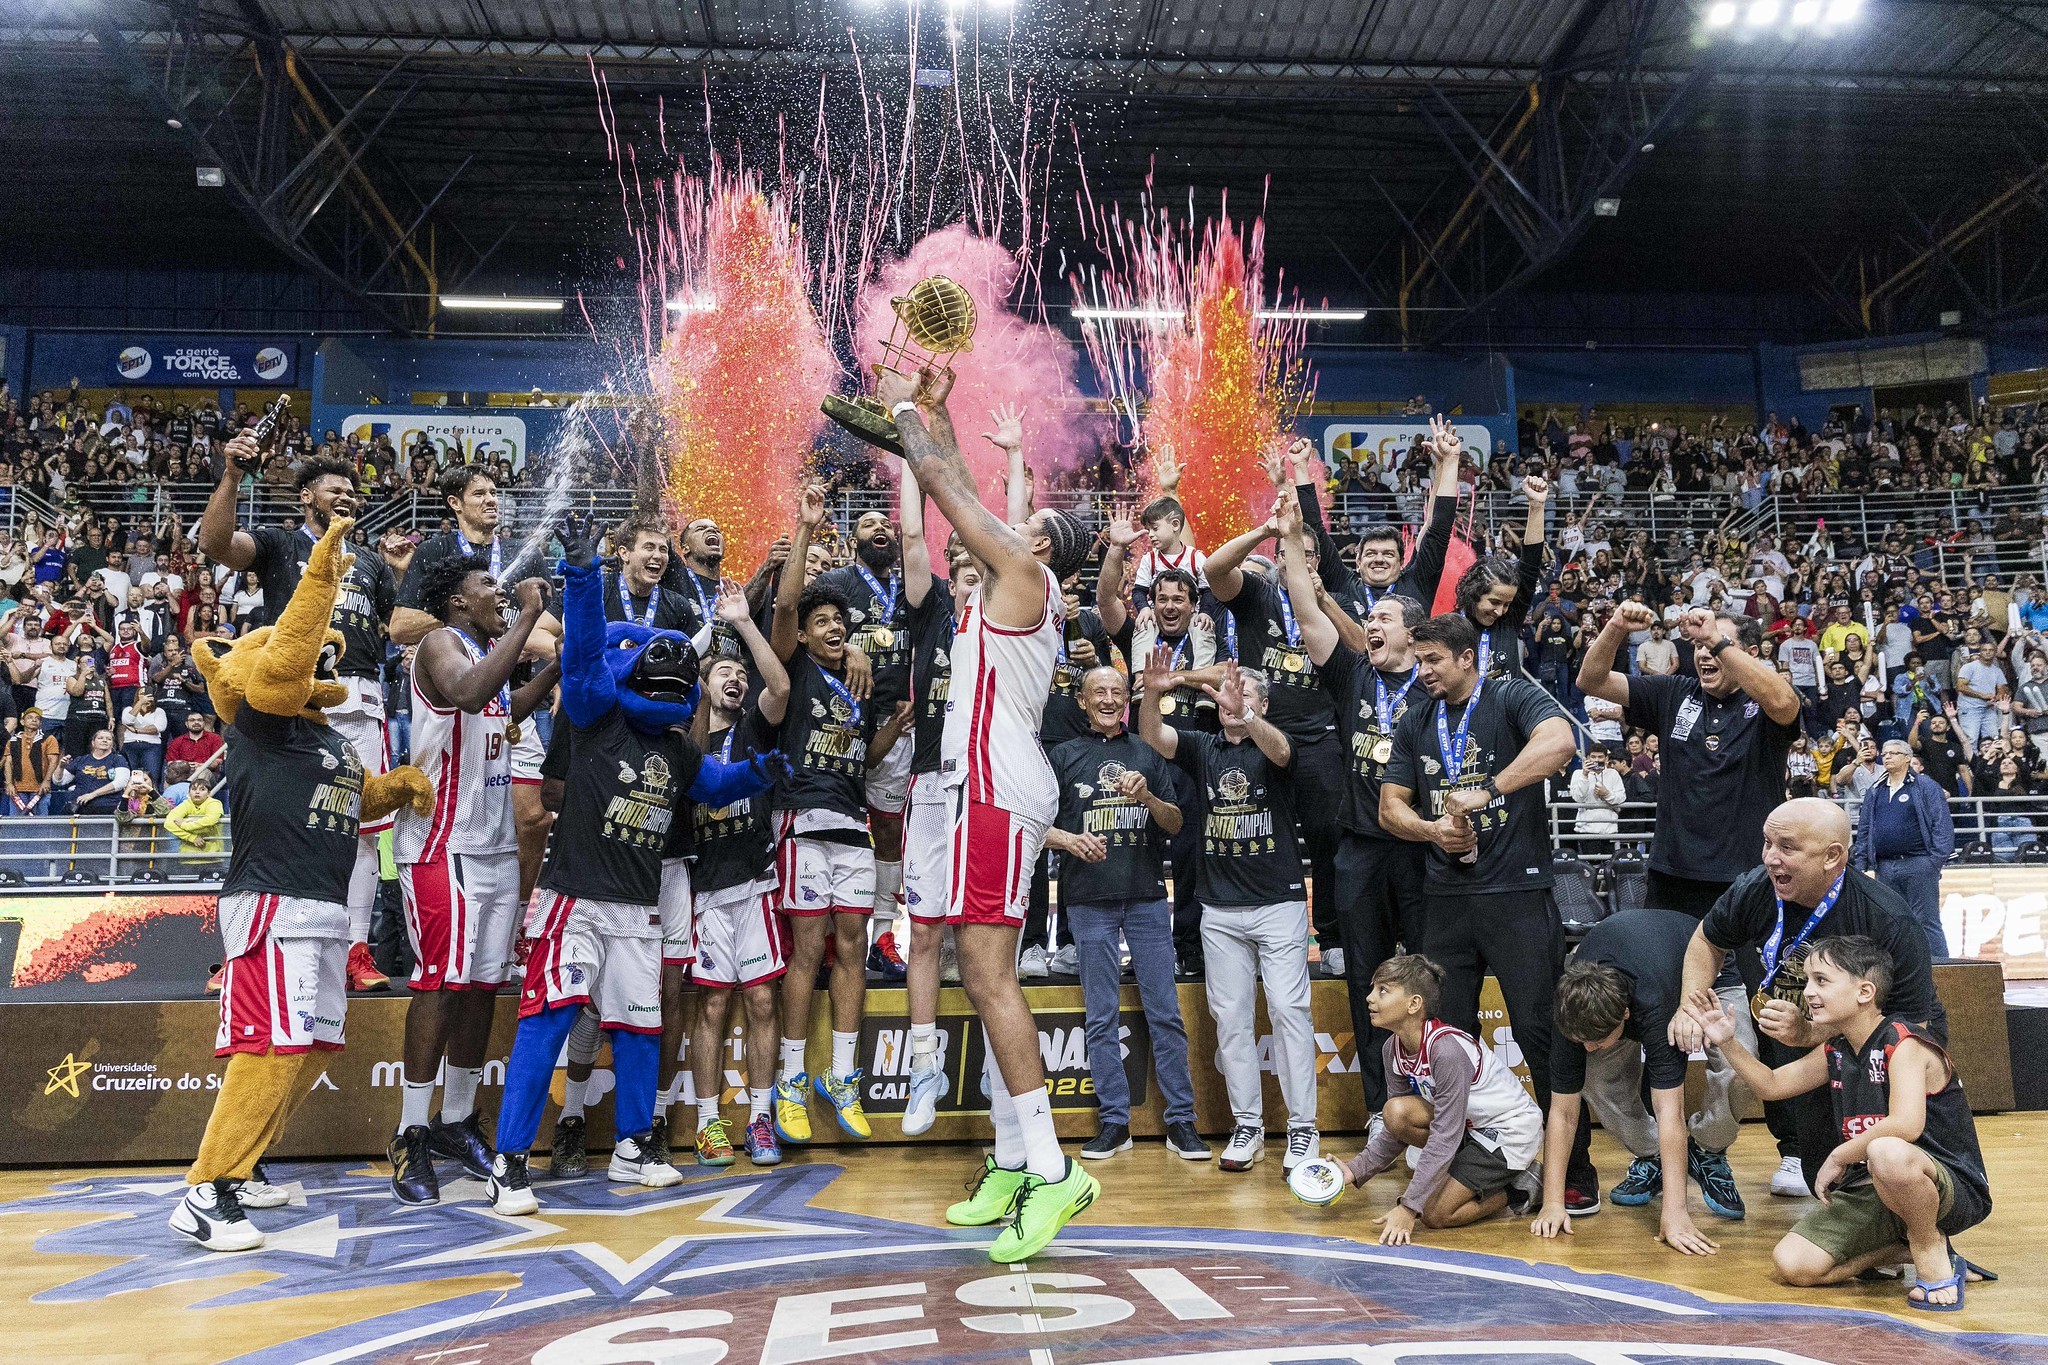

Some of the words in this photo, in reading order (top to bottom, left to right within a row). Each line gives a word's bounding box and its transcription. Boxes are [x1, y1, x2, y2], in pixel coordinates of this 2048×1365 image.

[186, 347, 219, 358] gente
[120, 353, 147, 373] EPTV
[163, 355, 230, 370] TORCE
[257, 354, 283, 373] EPTV
[485, 733, 502, 760] 19
[739, 953, 767, 968] Unimed
[314, 1016, 341, 1027] nimed
[94, 1062, 157, 1073] Universidades
[92, 1073, 166, 1091] Cruzeiro
[177, 1073, 201, 1091] do
[1869, 1070, 1885, 1082] SES
[531, 1272, 1235, 1365] SESI
